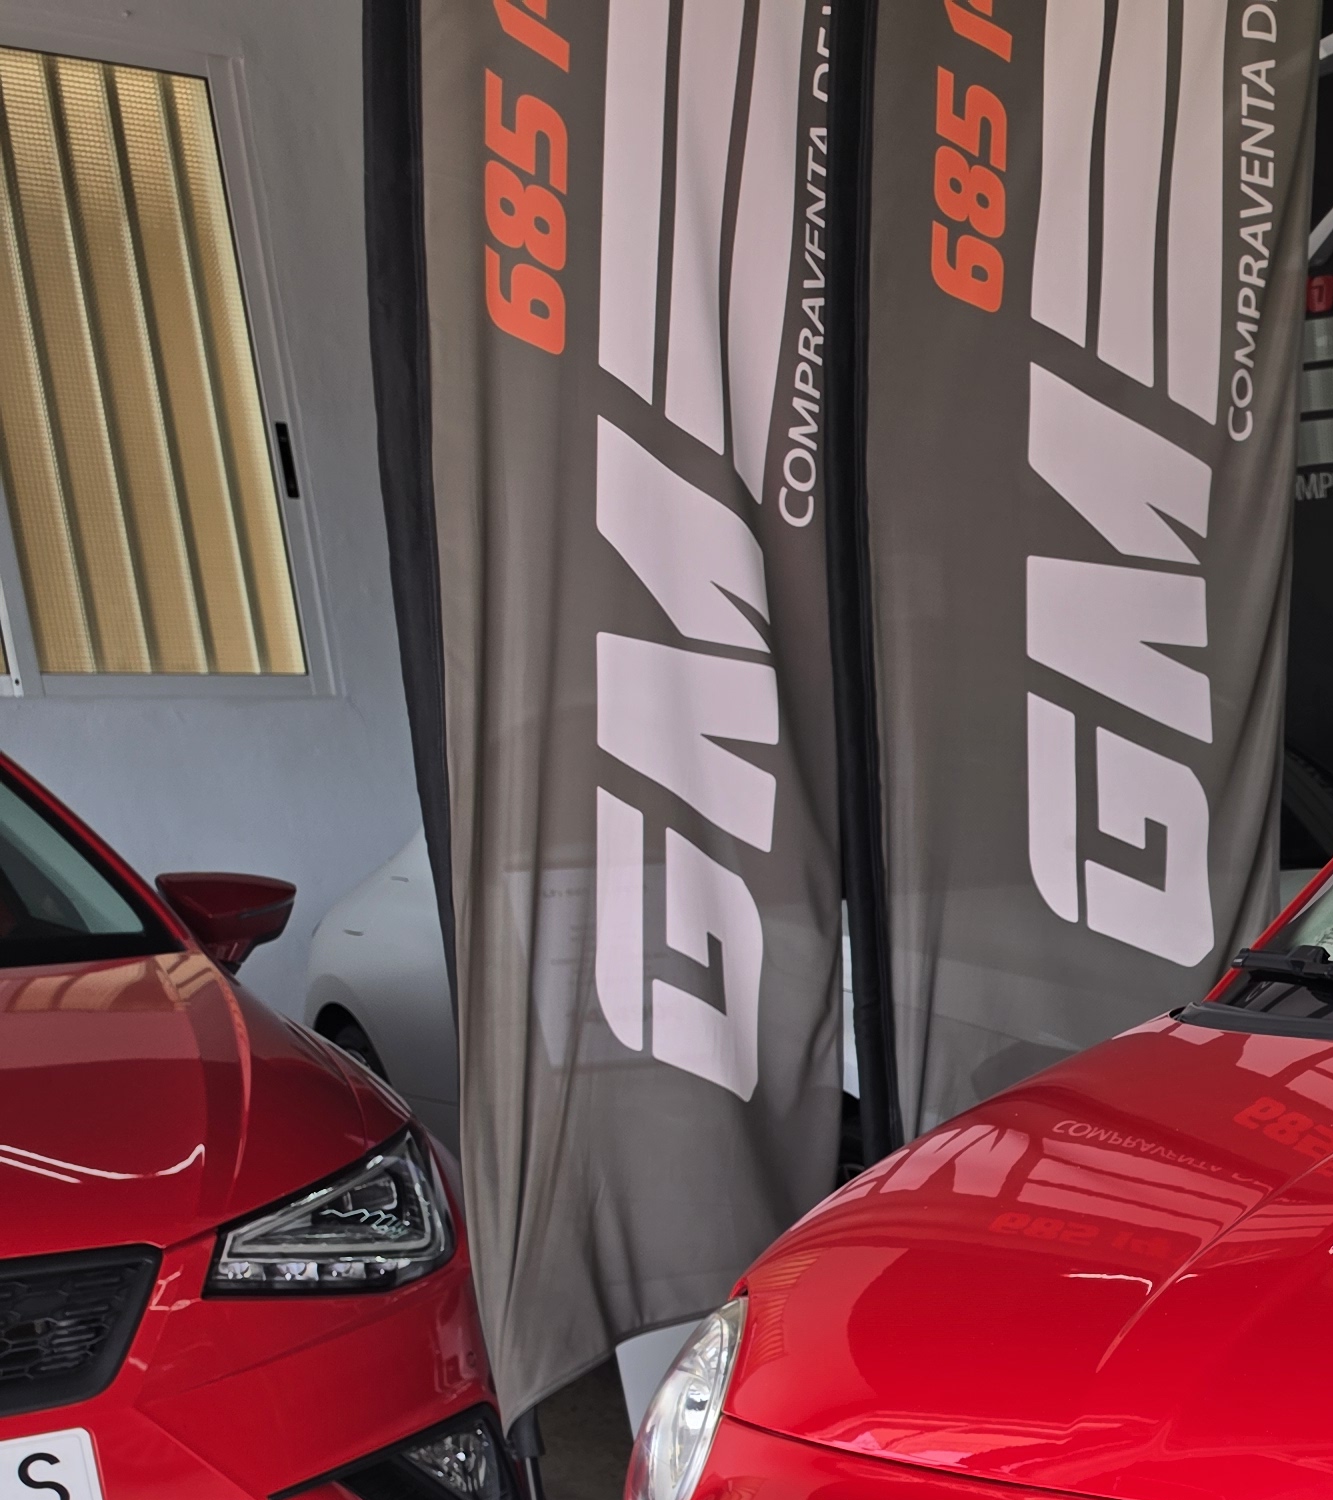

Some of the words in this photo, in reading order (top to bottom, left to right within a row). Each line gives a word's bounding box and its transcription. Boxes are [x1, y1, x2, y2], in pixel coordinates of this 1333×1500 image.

[931, 65, 1007, 313] 685
[1241, 0, 1278, 44] D
[485, 67, 569, 355] 685
[1228, 58, 1277, 442] COMPRAVENTA
[596, 414, 779, 1102] GM
[1026, 361, 1215, 968] GM
